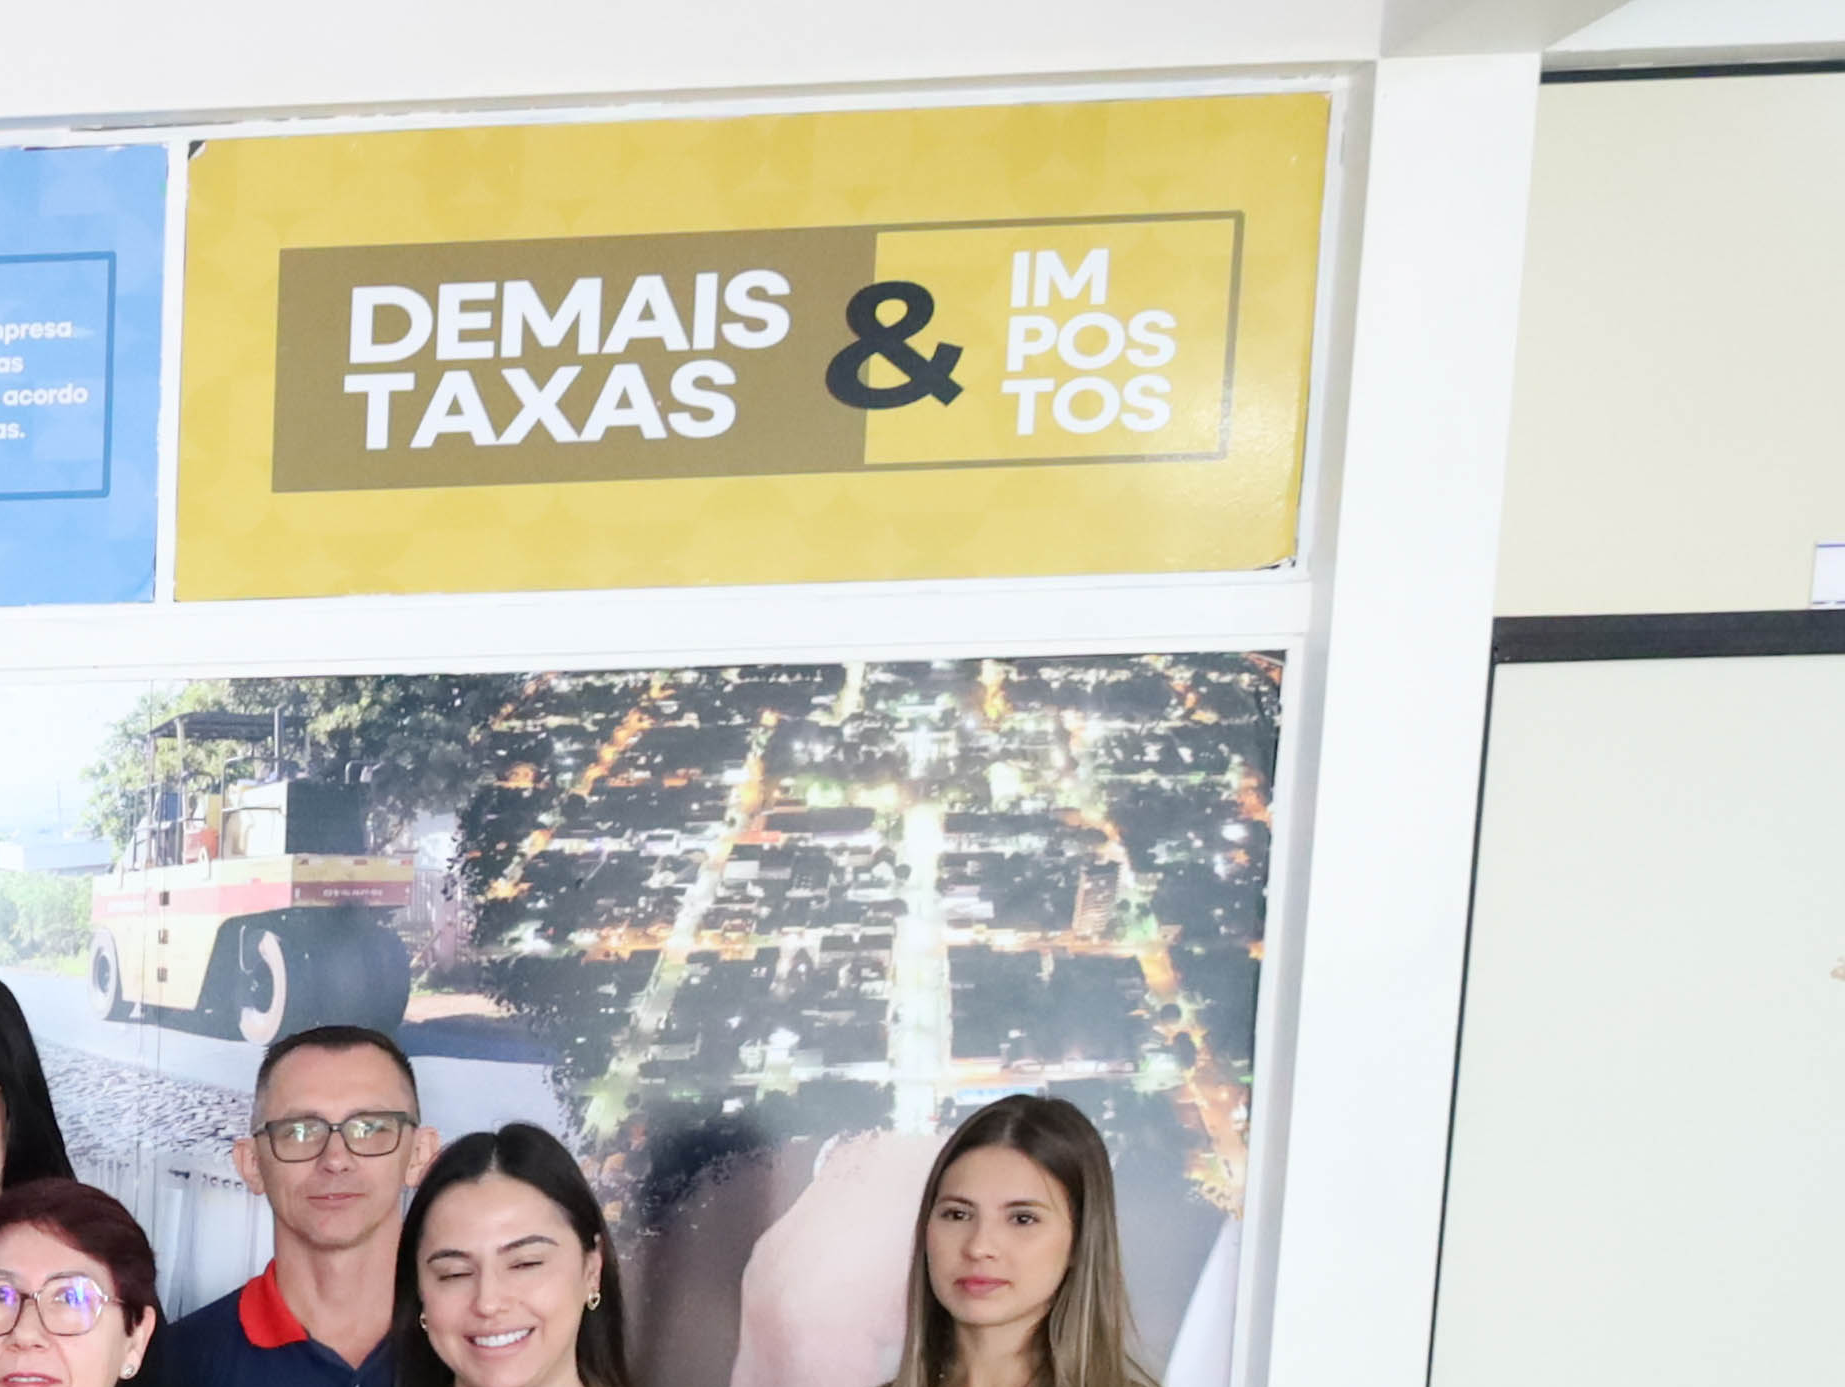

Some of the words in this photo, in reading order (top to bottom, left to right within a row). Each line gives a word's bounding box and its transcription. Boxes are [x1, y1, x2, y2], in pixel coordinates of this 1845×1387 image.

[1010, 247, 1109, 307] IM
[348, 268, 791, 363] DEMAIS
[826, 280, 963, 410] &
[1007, 308, 1176, 373] POS
[3, 382, 89, 406] acordo
[344, 359, 736, 450] TAXAS
[1001, 374, 1170, 435] TOS
